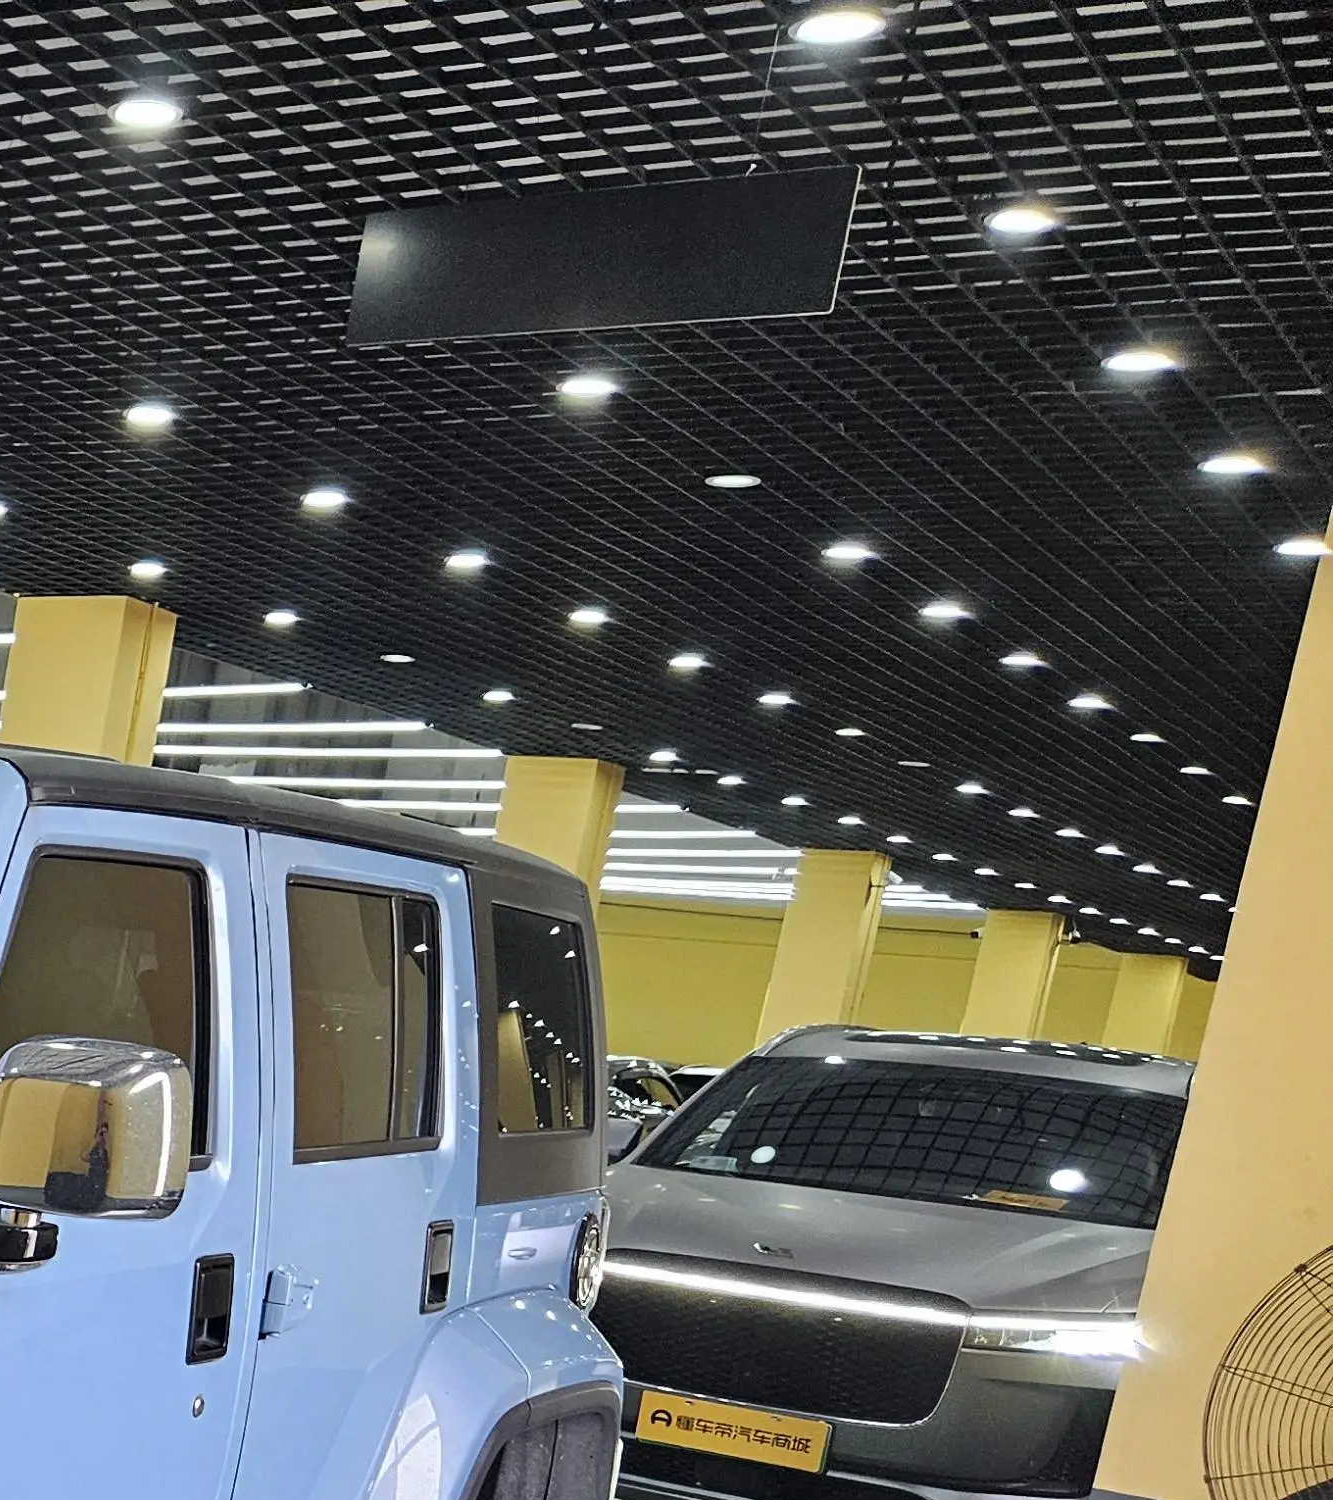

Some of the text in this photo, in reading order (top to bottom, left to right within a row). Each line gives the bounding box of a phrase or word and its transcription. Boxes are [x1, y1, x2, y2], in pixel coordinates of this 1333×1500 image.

[675, 1415, 812, 1454] 懂车帝汽车商城
